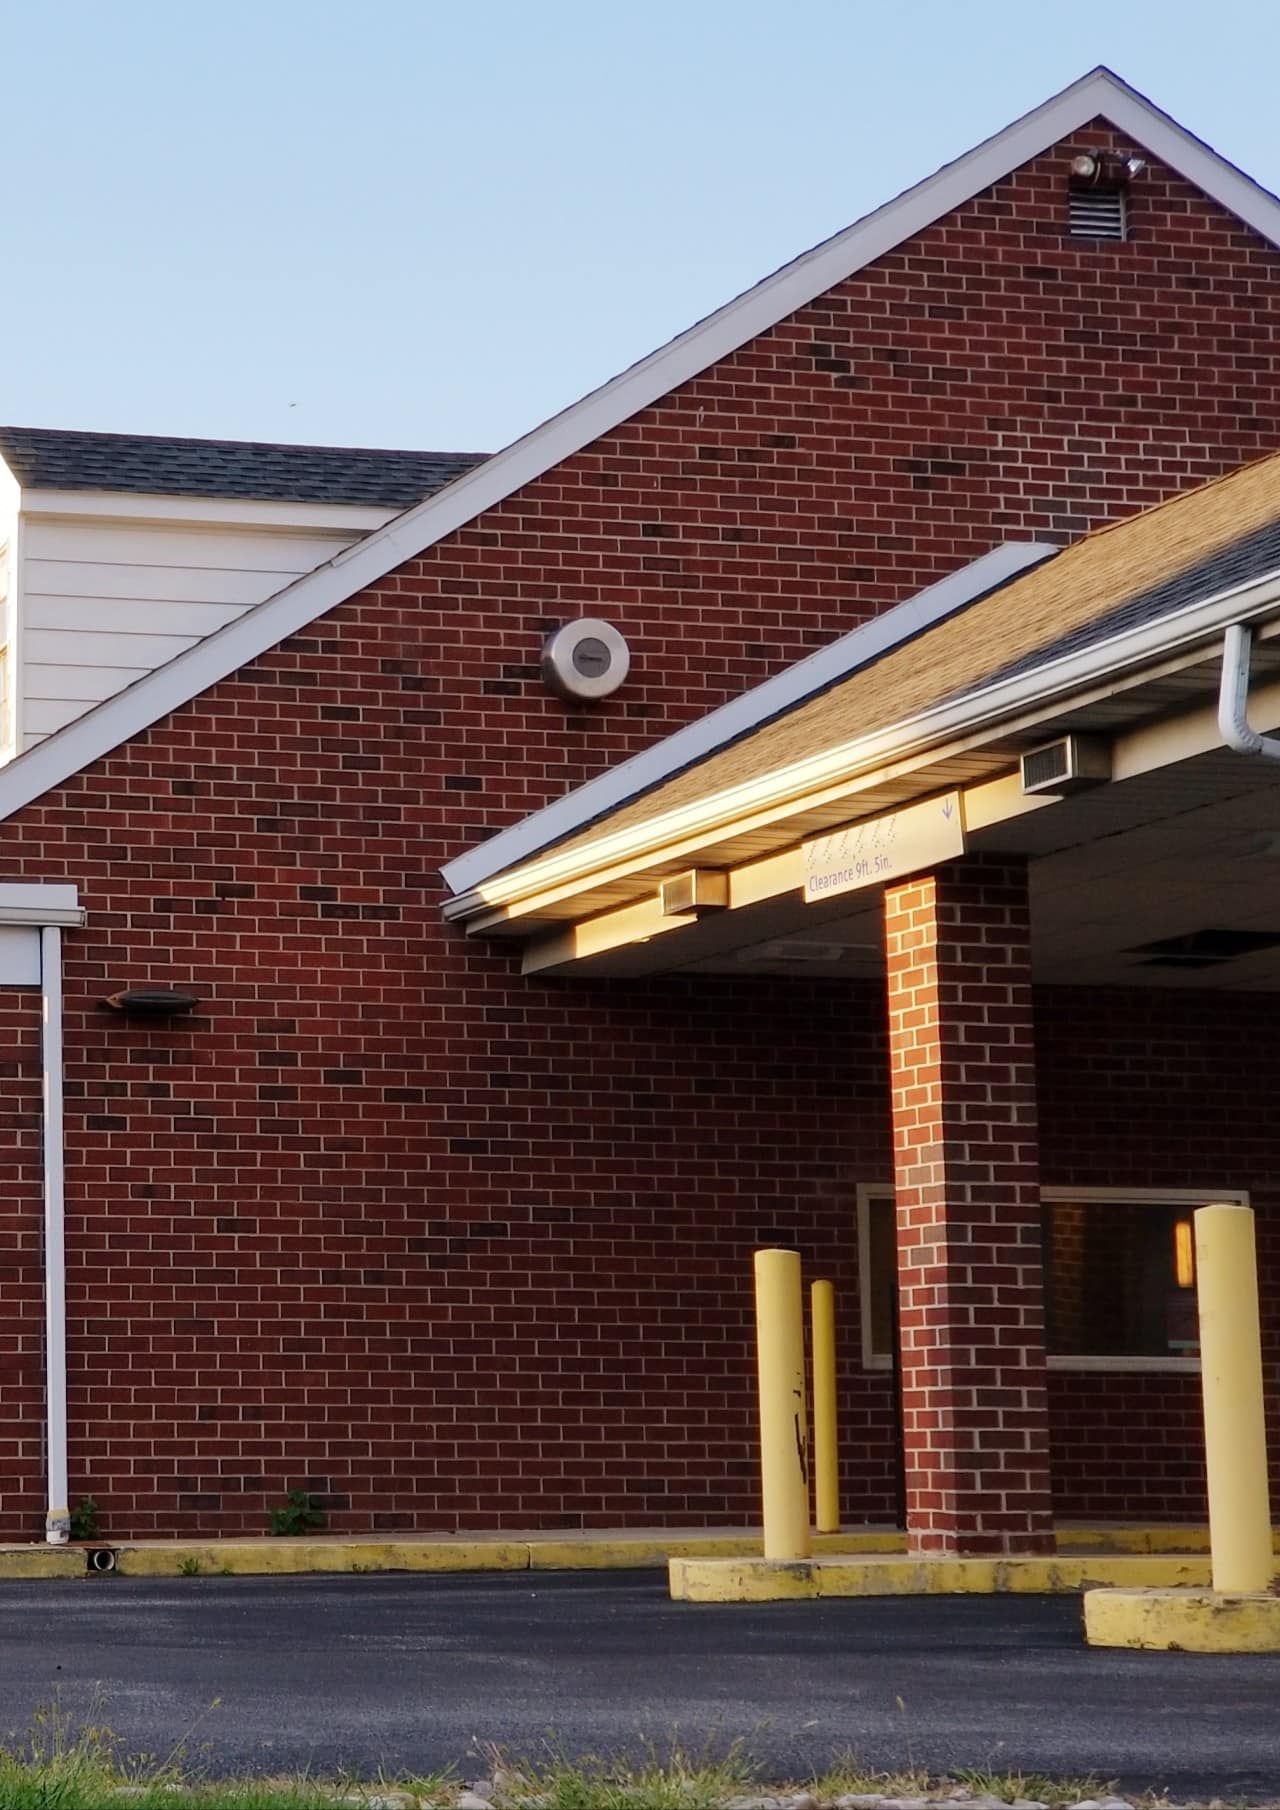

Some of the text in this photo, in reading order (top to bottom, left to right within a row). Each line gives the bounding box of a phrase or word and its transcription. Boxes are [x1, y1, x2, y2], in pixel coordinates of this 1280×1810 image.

[809, 853, 893, 892] Clearance 9ft. 5in.
